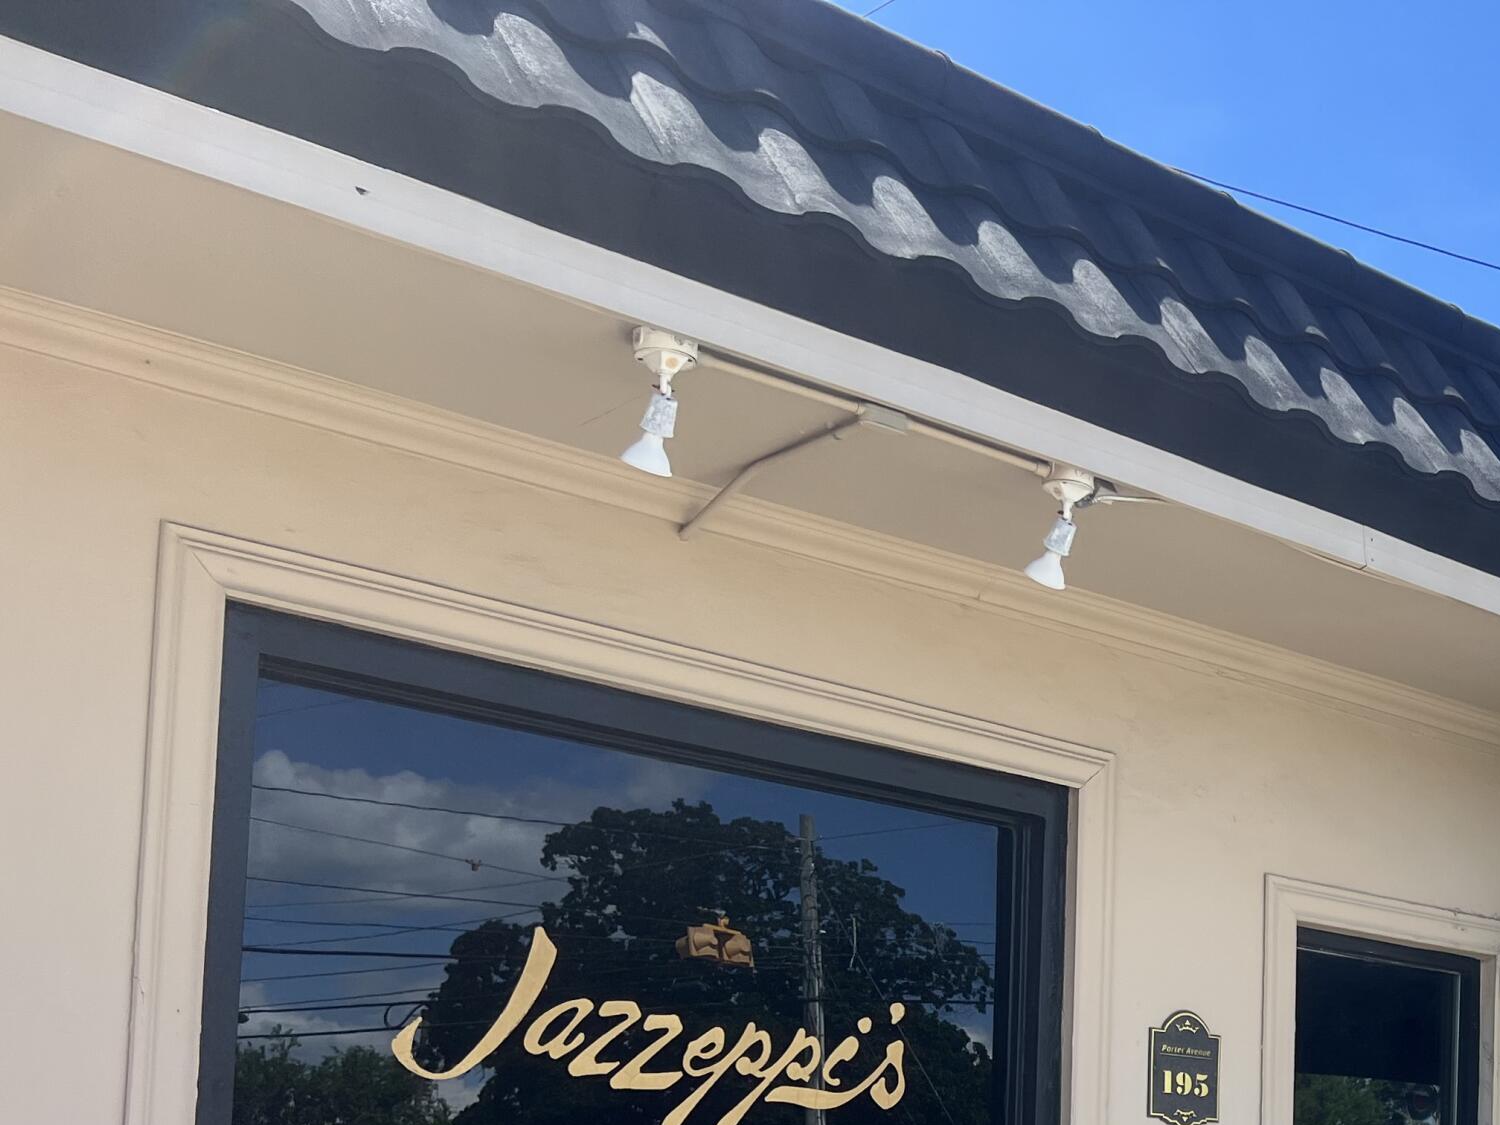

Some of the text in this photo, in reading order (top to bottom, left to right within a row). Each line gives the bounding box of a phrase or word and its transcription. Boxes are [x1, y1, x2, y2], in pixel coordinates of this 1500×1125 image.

[1161, 1044, 1212, 1057] Porter Avenue
[1163, 1069, 1209, 1098] 195
